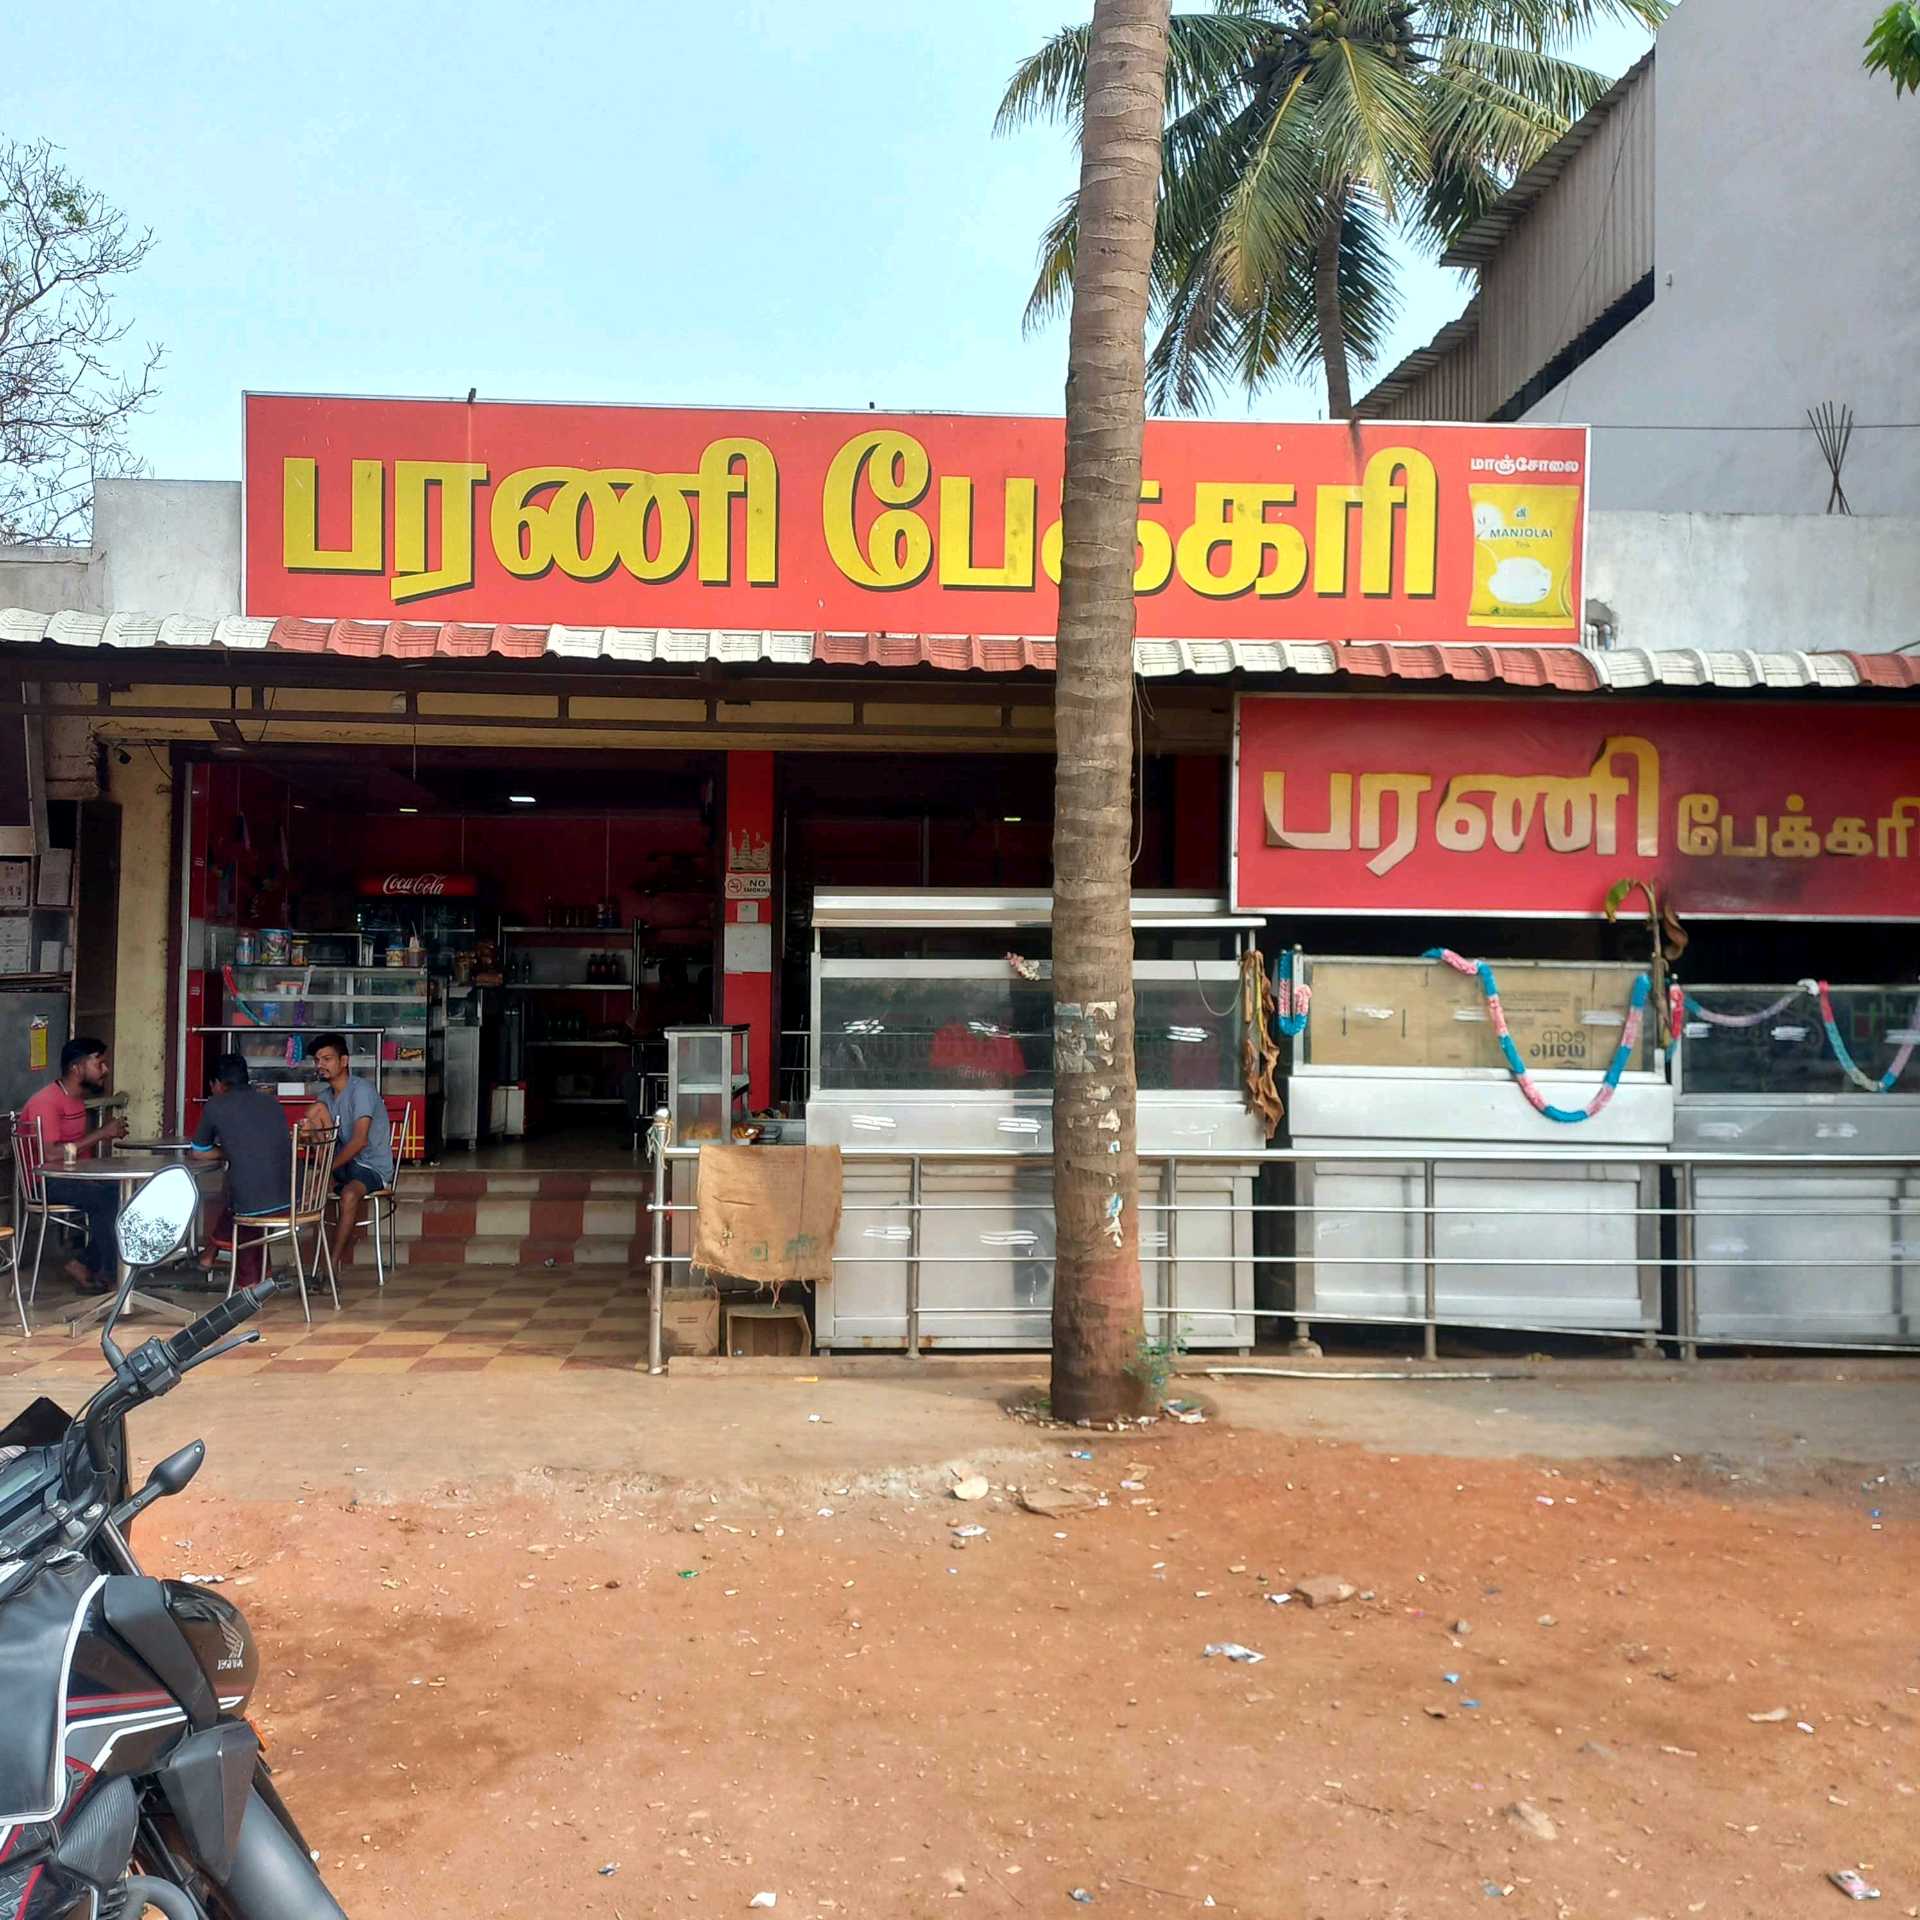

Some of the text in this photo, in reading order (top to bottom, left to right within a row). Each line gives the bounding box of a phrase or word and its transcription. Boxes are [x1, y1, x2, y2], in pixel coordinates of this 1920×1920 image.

[1471, 454, 1579, 476] மாஞ்சோலை
[283, 437, 777, 601] பரணி
[1490, 528, 1553, 539] MANJOLAI
[1264, 736, 1920, 877] பரணி பேக்கரி
[750, 879, 767, 888] NO
[1541, 1030, 1586, 1043] GOLD
[1530, 1042, 1586, 1059] marie
